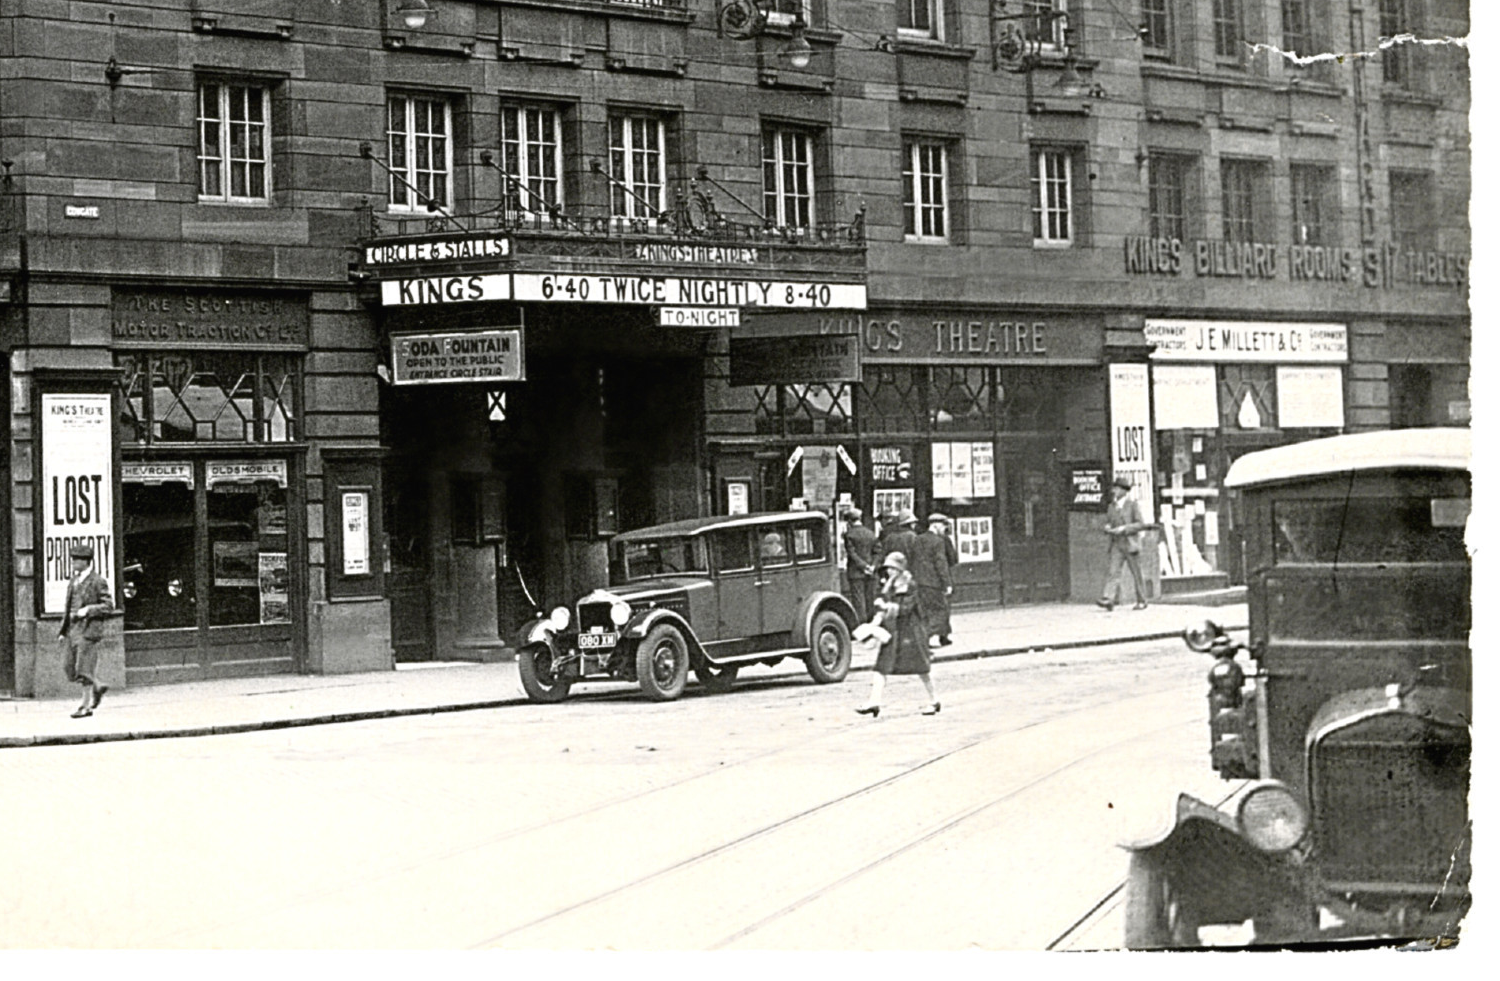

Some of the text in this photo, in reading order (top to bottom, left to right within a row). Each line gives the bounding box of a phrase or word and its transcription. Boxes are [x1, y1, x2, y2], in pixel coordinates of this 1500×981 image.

[372, 244, 426, 264] CIRCLE
[444, 239, 503, 259] STALLS
[1194, 240, 1277, 279] BILLIARD
[1290, 245, 1351, 283] ROOMS
[400, 276, 484, 304] KINGS
[599, 277, 666, 303] TWICE
[679, 278, 772, 305] NIGHTLY
[133, 294, 284, 316] THE SCOTTISH
[113, 321, 170, 338] MOTOR
[176, 321, 249, 341] TRACTION
[932, 321, 1046, 353] THEATRE
[1209, 328, 1216, 350] E
[1222, 328, 1275, 351] MILLETT
[1279, 332, 1286, 351] &
[402, 337, 510, 357] SODA FOUNTAIN
[406, 354, 504, 367] OPEN TO THE PUBLIC
[1117, 426, 1145, 463] LOST
[212, 466, 280, 475] OLDSMOBILE
[873, 465, 896, 481] OFFICE
[53, 474, 102, 526] LOST
